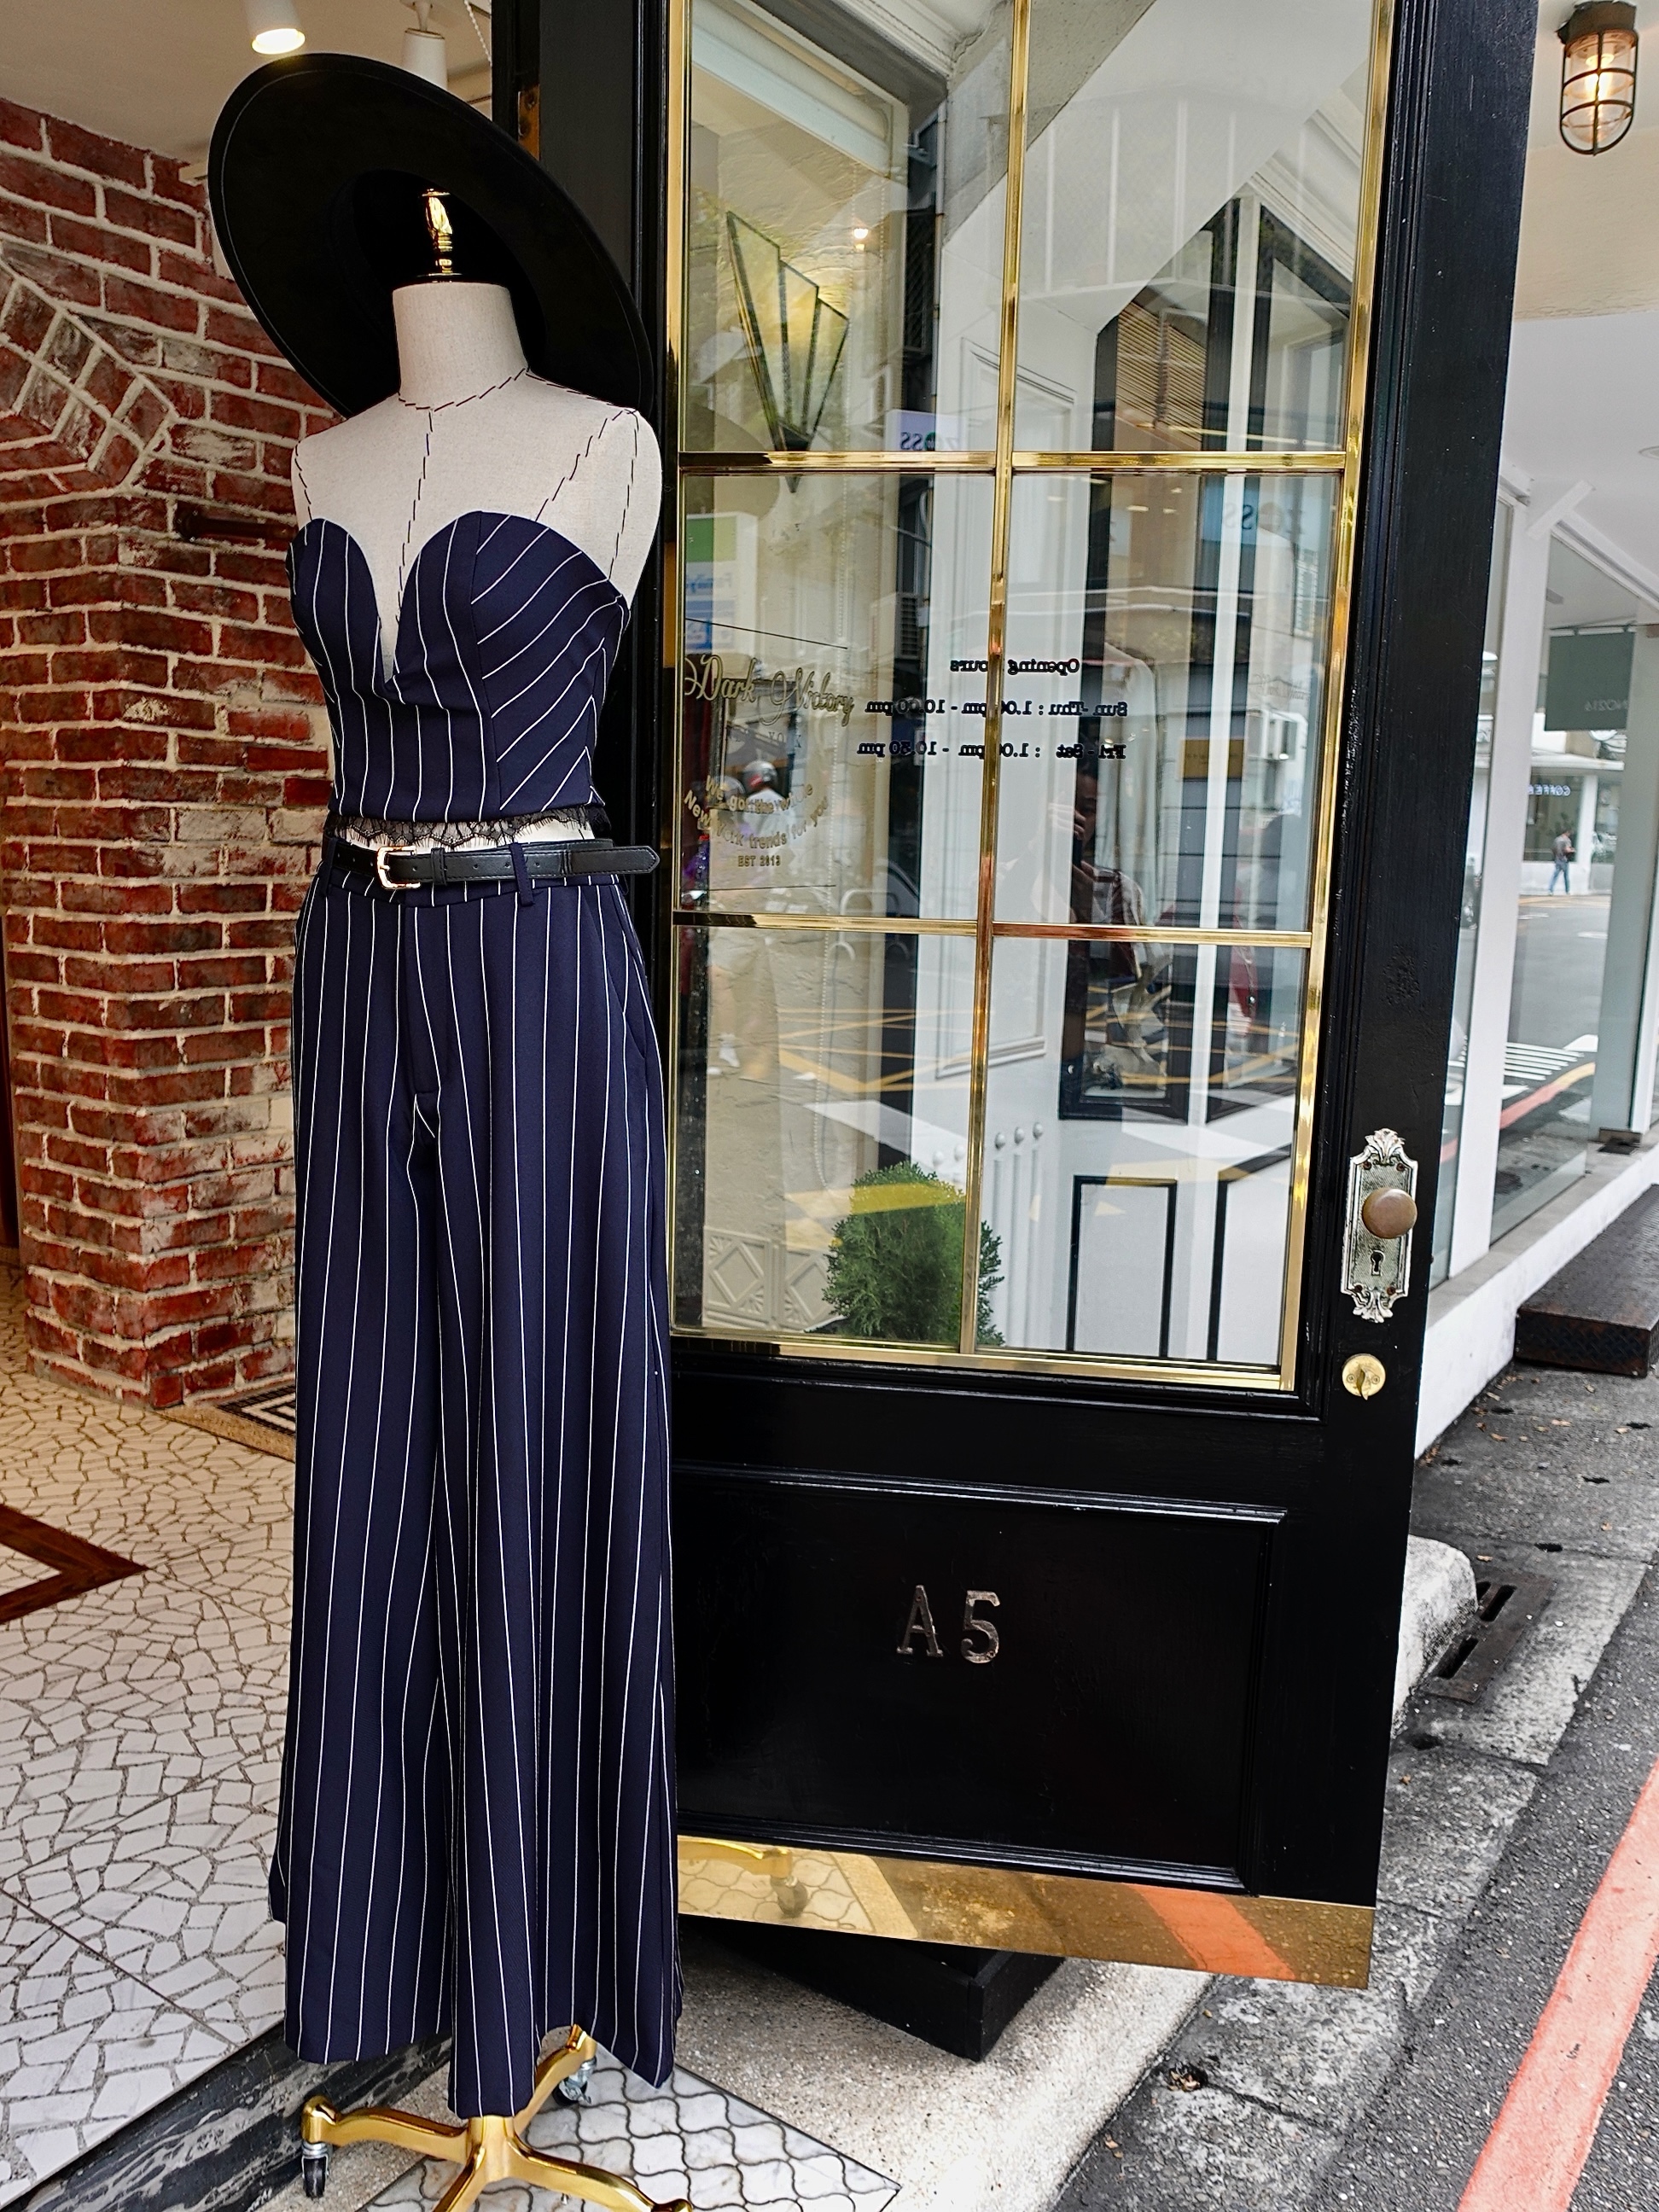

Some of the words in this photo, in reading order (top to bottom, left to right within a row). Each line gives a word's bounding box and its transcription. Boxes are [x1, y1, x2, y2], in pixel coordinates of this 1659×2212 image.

[684, 654, 756, 703] Dark
[760, 667, 854, 727] Victory
[705, 774, 725, 800] We
[684, 789, 713, 827] New
[749, 831, 787, 849] trends
[737, 855, 756, 867] EST
